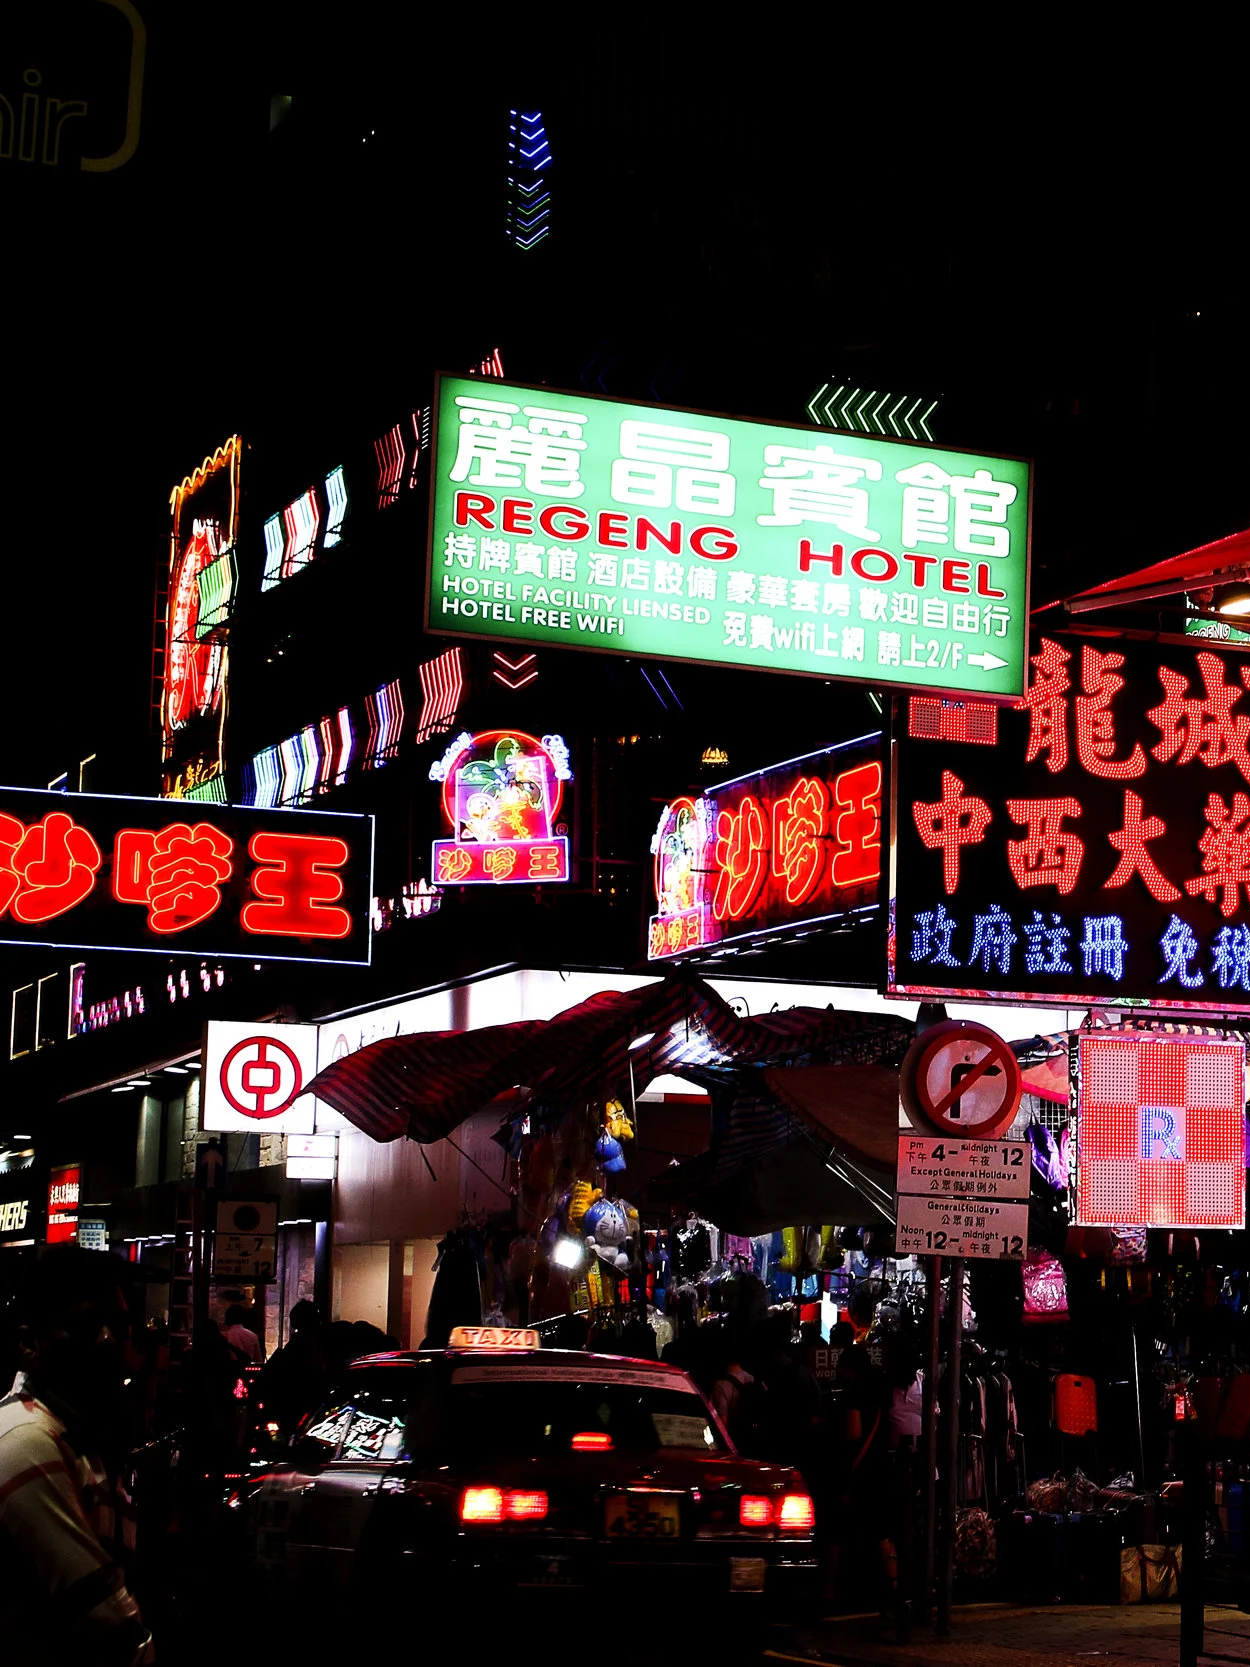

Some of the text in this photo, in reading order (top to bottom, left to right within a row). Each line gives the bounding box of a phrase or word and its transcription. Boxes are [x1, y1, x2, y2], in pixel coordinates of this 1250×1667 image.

[449, 396, 1018, 558] 麗晶賓館
[454, 489, 1006, 600] REGENG HOTEL
[443, 531, 1011, 638] 持牌賓館 酒店設備 豪華套房 歡迎自由行
[442, 575, 712, 626] HOTEL FACILITY LIENSED
[441, 596, 626, 636] HOTEL FREE WIFI
[909, 902, 1129, 982] 政府註冊
[906, 1152, 990, 1167] 下午 午夜
[909, 1141, 924, 1150] pm
[1001, 1148, 1024, 1166] 12
[911, 1166, 1017, 1181] Except General Holidays
[927, 1202, 962, 1211] General
[253, 1237, 264, 1252] 7
[901, 1225, 924, 1235] Noon
[962, 1230, 999, 1241] midnight
[1001, 1235, 1024, 1255] 12
[901, 1238, 991, 1255] 中午 午夜
[253, 1261, 272, 1275] 12
[462, 1328, 534, 1346] TAXI
